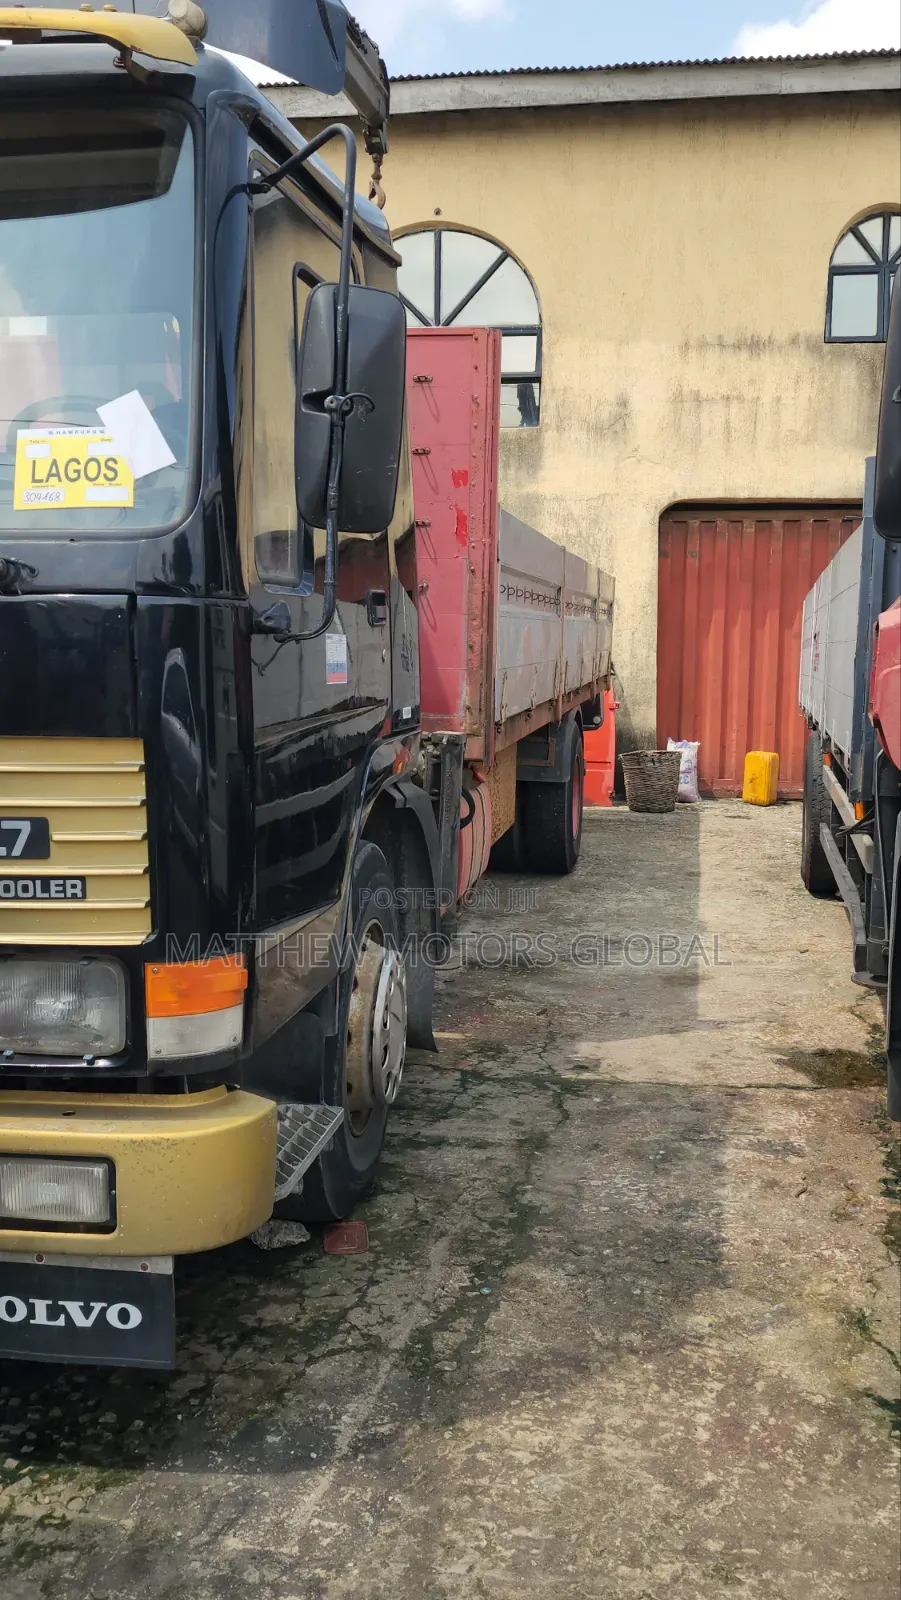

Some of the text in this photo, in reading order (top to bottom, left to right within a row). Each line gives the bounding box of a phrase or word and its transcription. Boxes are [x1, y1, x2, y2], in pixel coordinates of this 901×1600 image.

[31, 457, 118, 484] LAGOS
[23, 491, 61, 503] 304168
[0, 820, 31, 857] 7
